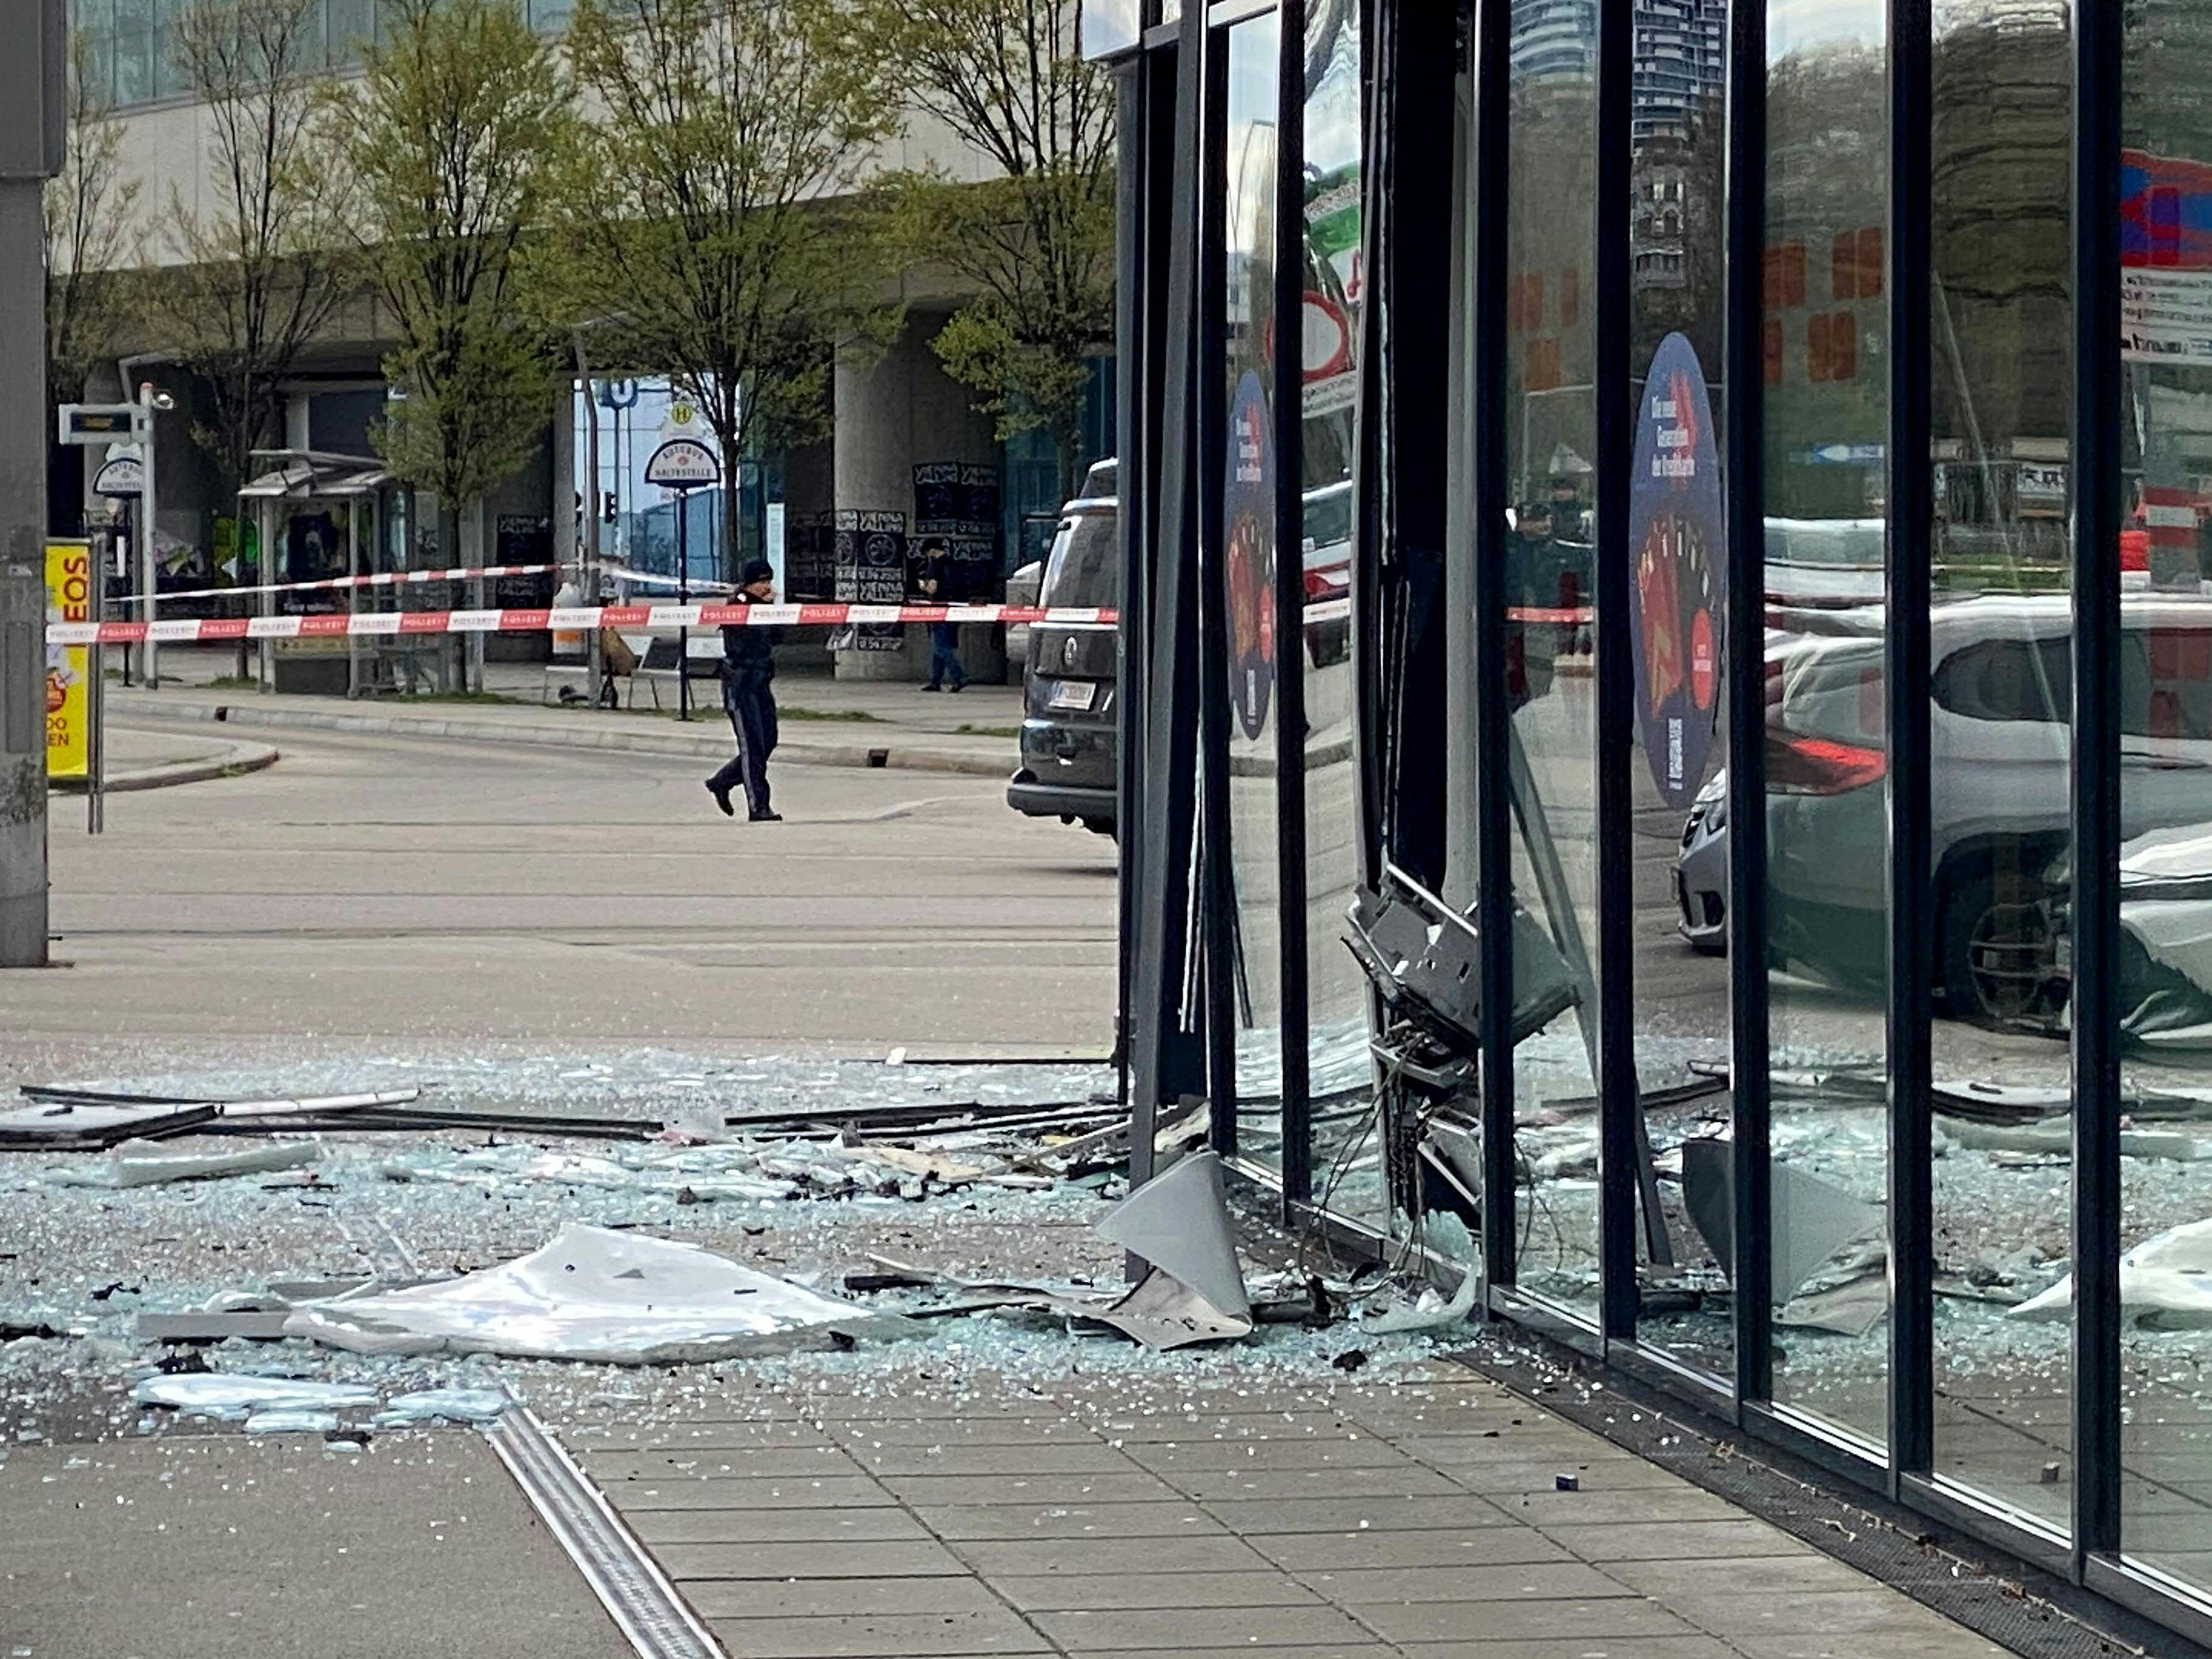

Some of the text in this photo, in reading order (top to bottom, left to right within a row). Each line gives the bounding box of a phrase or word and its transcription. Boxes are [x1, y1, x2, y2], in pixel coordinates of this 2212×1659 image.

[676, 408, 687, 422] H
[63, 557, 87, 647] EOS
[48, 733, 69, 746] EN
